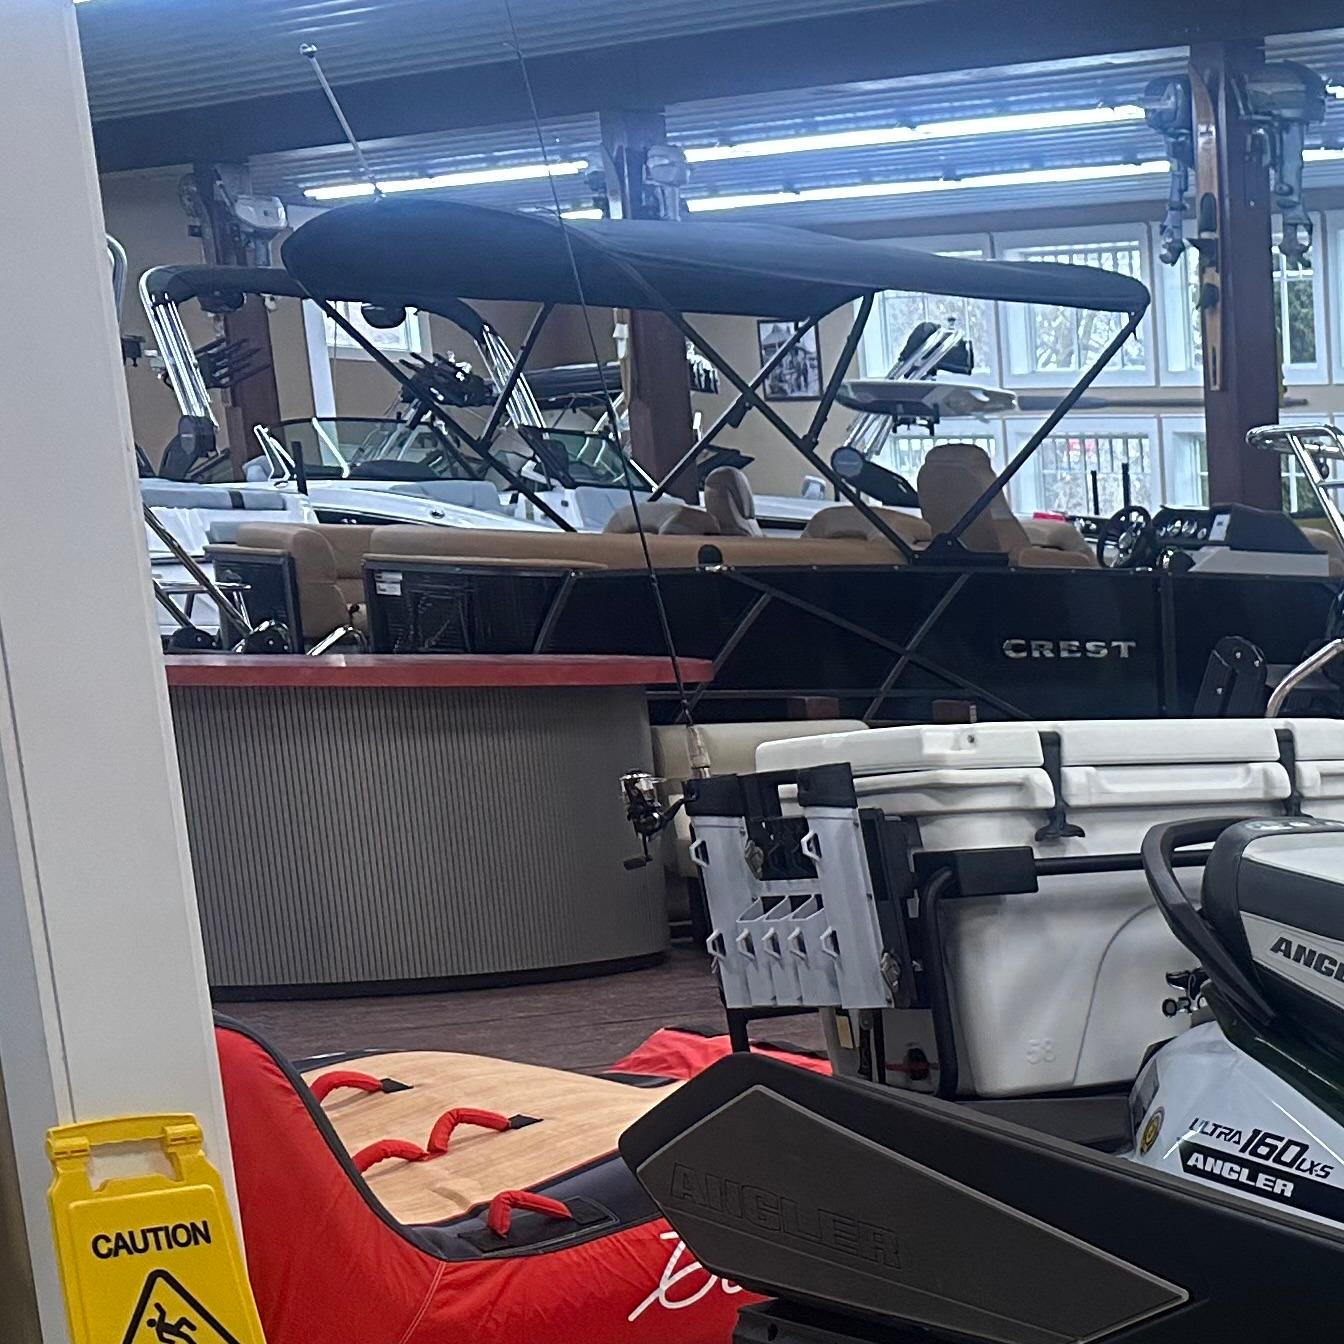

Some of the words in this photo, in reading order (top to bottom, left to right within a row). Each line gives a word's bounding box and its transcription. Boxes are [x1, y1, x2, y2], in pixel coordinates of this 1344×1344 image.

[1002, 638, 1137, 659] CREST
[1188, 1117, 1242, 1146] ULTRA
[1187, 1152, 1295, 1198] ANGLER
[670, 1162, 901, 1270] ANGLER
[91, 1220, 212, 1259] CAUTION
